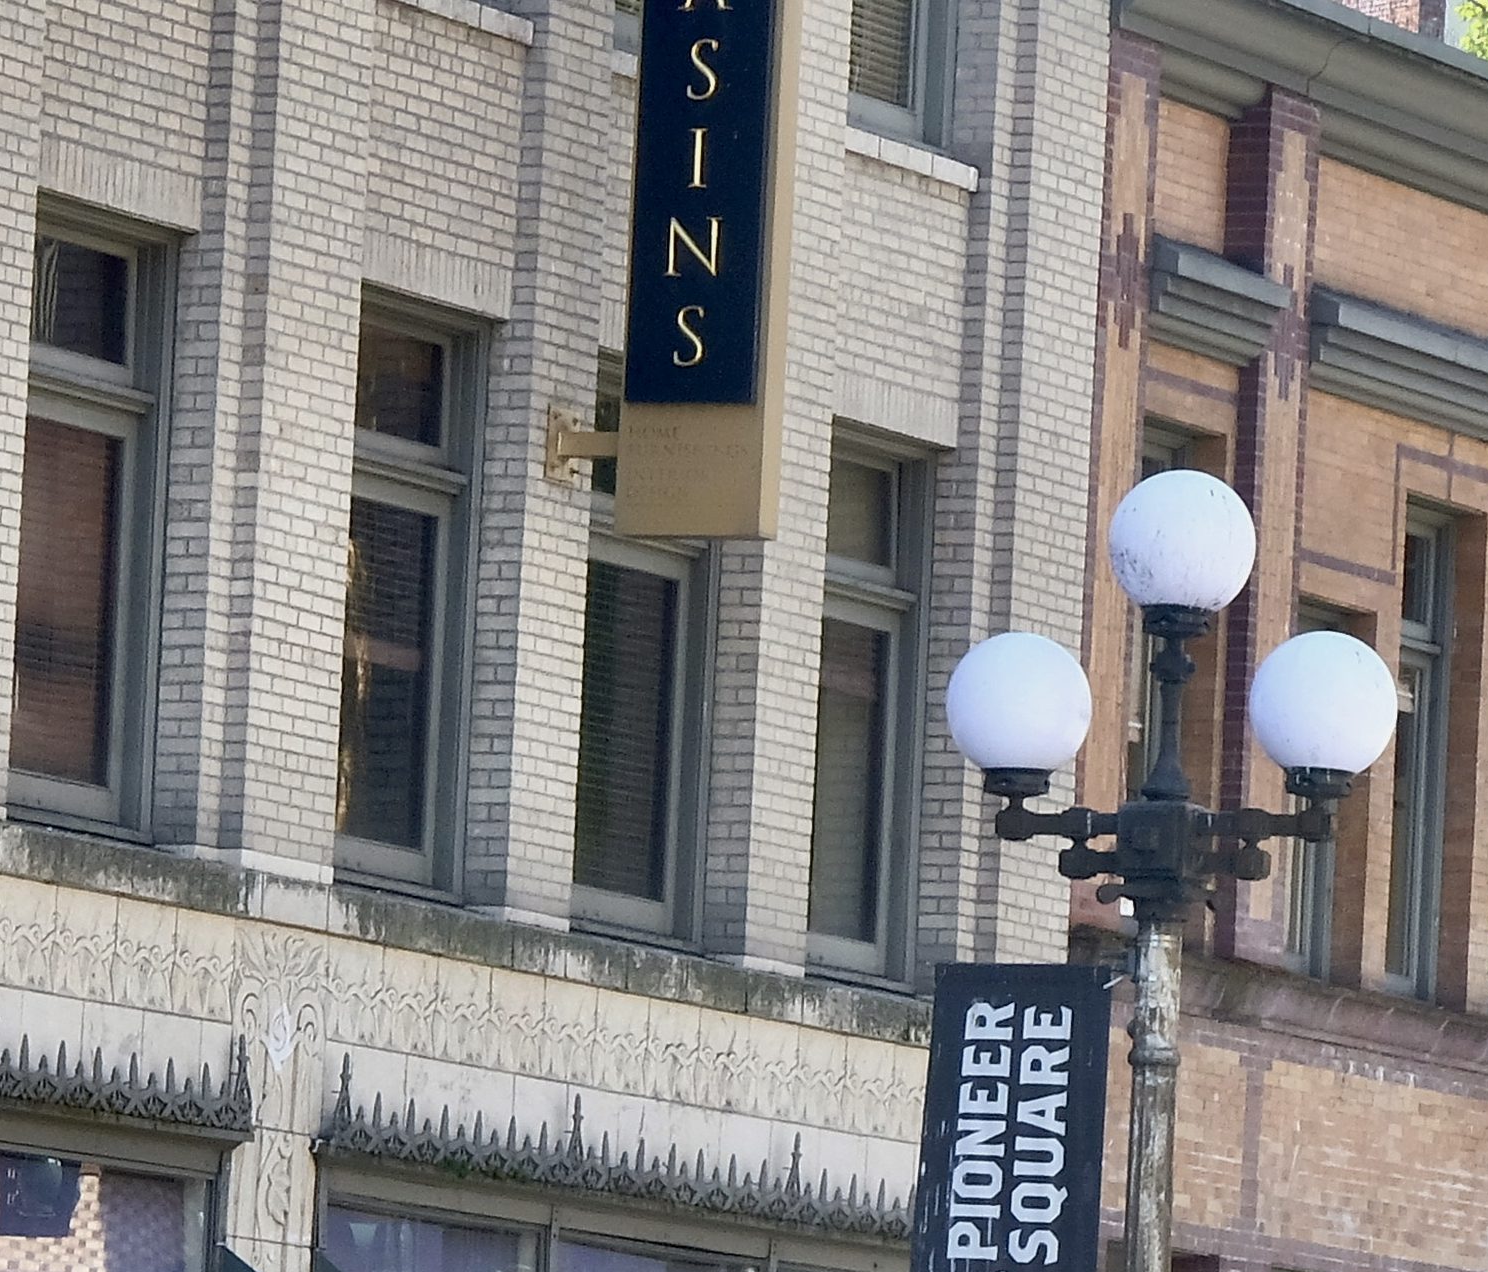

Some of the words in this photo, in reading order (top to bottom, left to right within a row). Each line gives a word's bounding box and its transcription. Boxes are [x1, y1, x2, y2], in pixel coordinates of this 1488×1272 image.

[665, 0, 733, 366] SINS
[947, 1001, 1015, 1261] PIONEER
[1008, 1005, 1072, 1265] SQUARE
